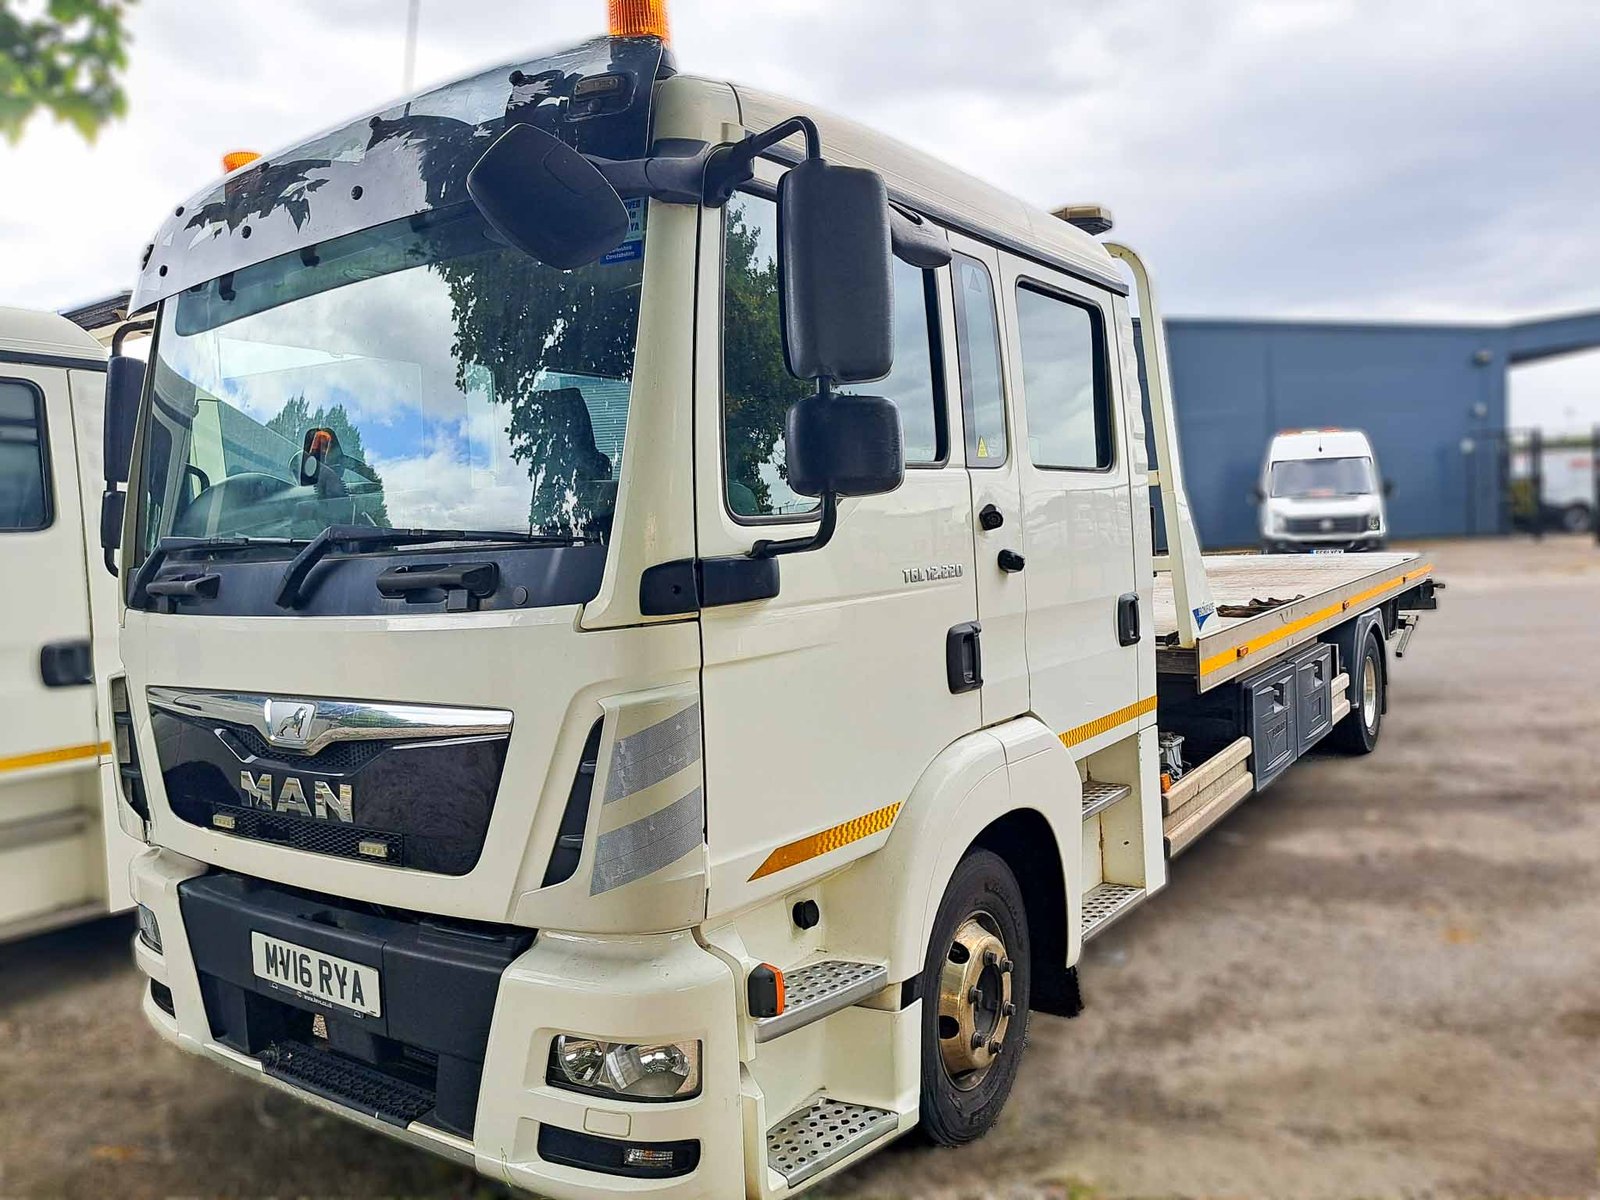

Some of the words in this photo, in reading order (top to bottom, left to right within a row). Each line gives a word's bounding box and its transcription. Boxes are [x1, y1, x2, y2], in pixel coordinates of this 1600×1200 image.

[902, 568, 925, 584] TGL
[240, 771, 353, 823] MAN
[265, 941, 312, 989] MV16
[319, 959, 365, 1007] RYA
